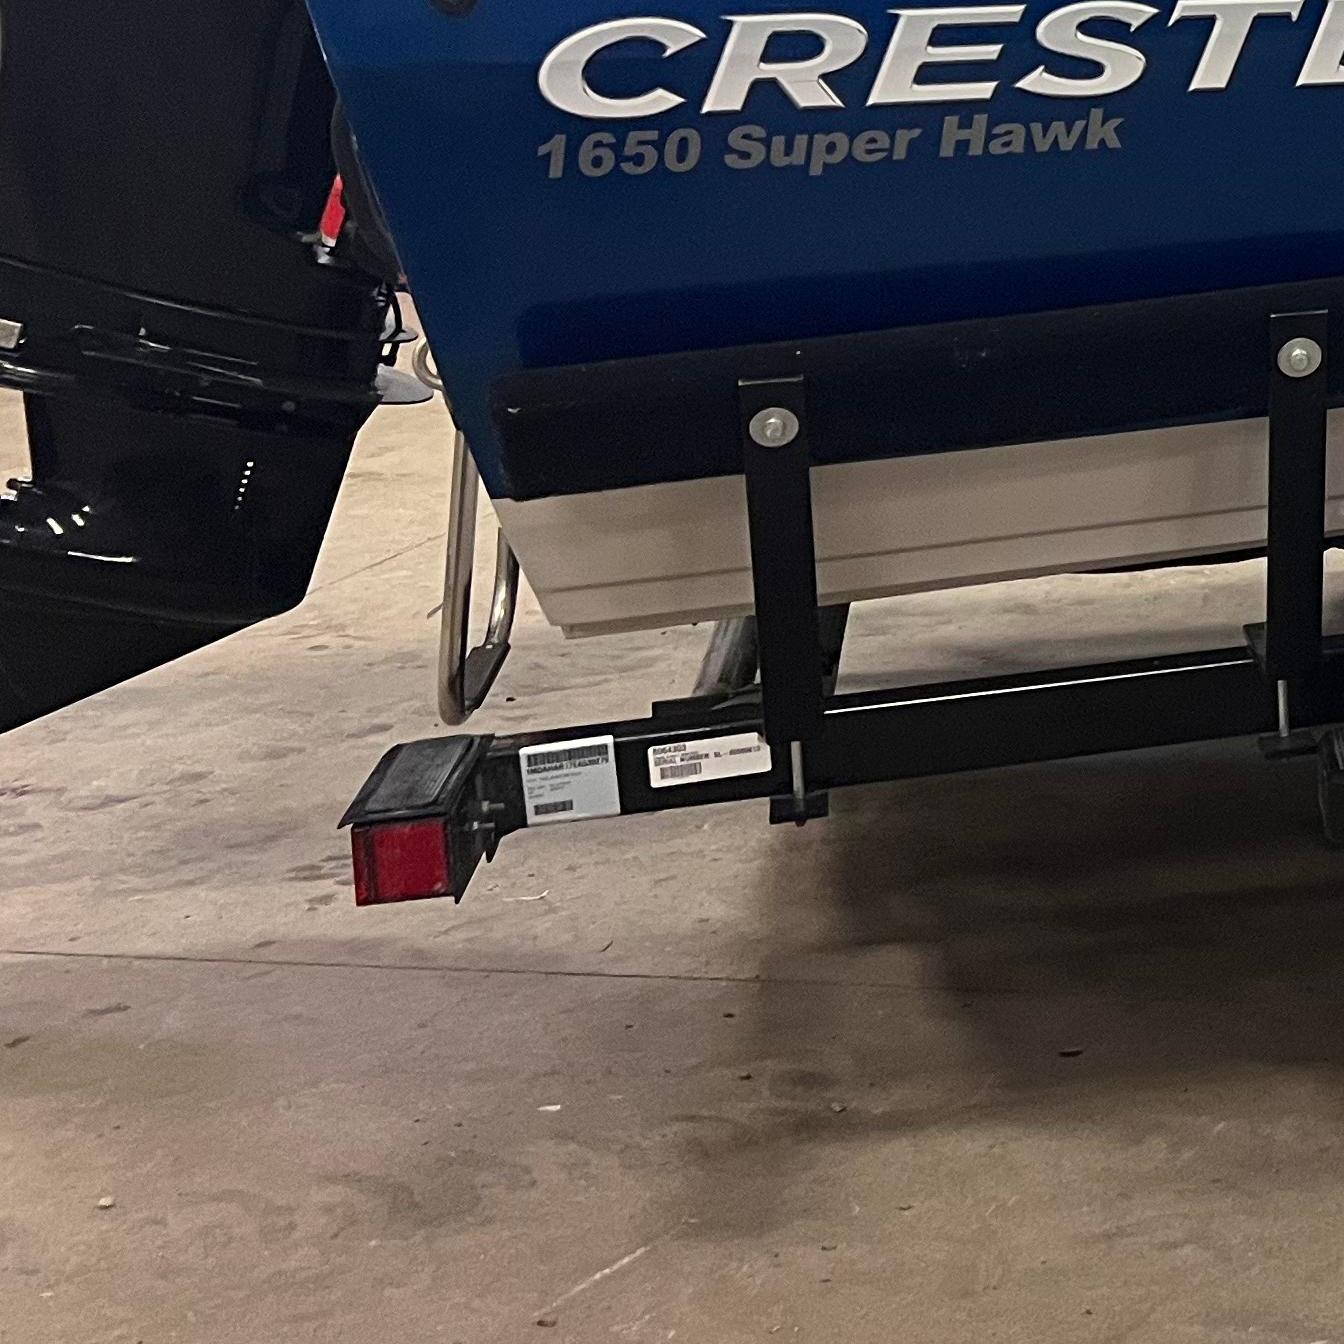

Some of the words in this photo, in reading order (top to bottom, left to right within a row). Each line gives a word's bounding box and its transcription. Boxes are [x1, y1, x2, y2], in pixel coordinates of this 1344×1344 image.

[536, 125, 702, 180] 1650
[723, 122, 922, 177] Super
[938, 107, 1126, 156] Hawk
